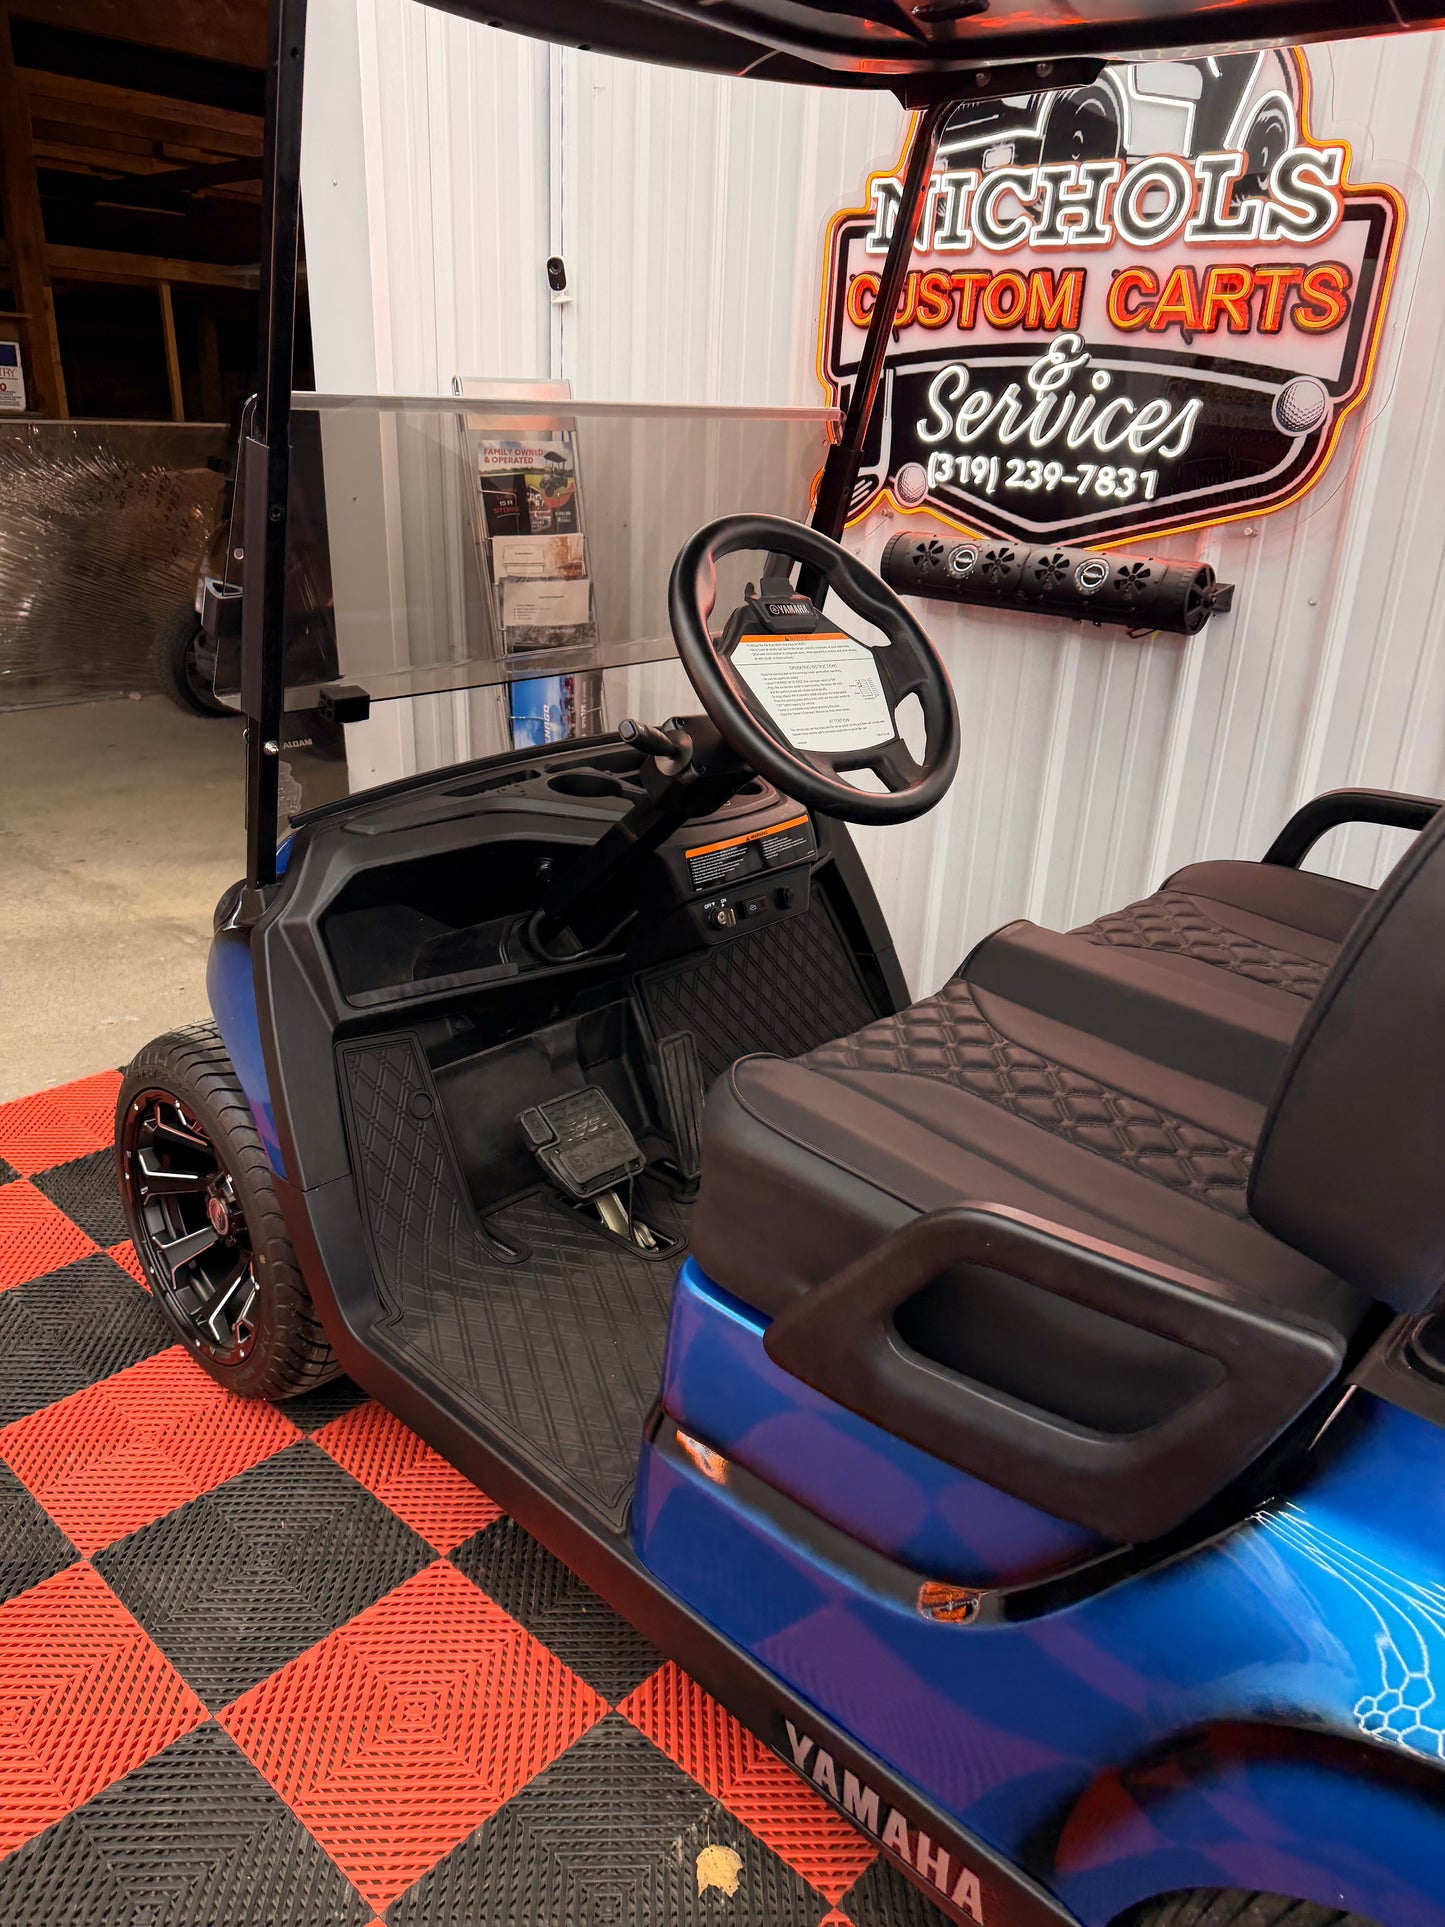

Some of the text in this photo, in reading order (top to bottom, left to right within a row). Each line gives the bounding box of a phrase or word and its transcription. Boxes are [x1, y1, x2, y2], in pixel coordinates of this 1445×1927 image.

[866, 147, 1344, 254] NICHOLS
[847, 262, 1354, 336] CUSTOM CARTS
[1028, 332, 1092, 400] &
[916, 364, 1204, 458] Services
[484, 448, 543, 456] FAMILY OWNED
[491, 456, 534, 464] OPERATED
[927, 451, 1159, 499] (319) 239-7831
[777, 604, 810, 614] YAMAHA
[784, 1718, 984, 1927] YAMAHA
